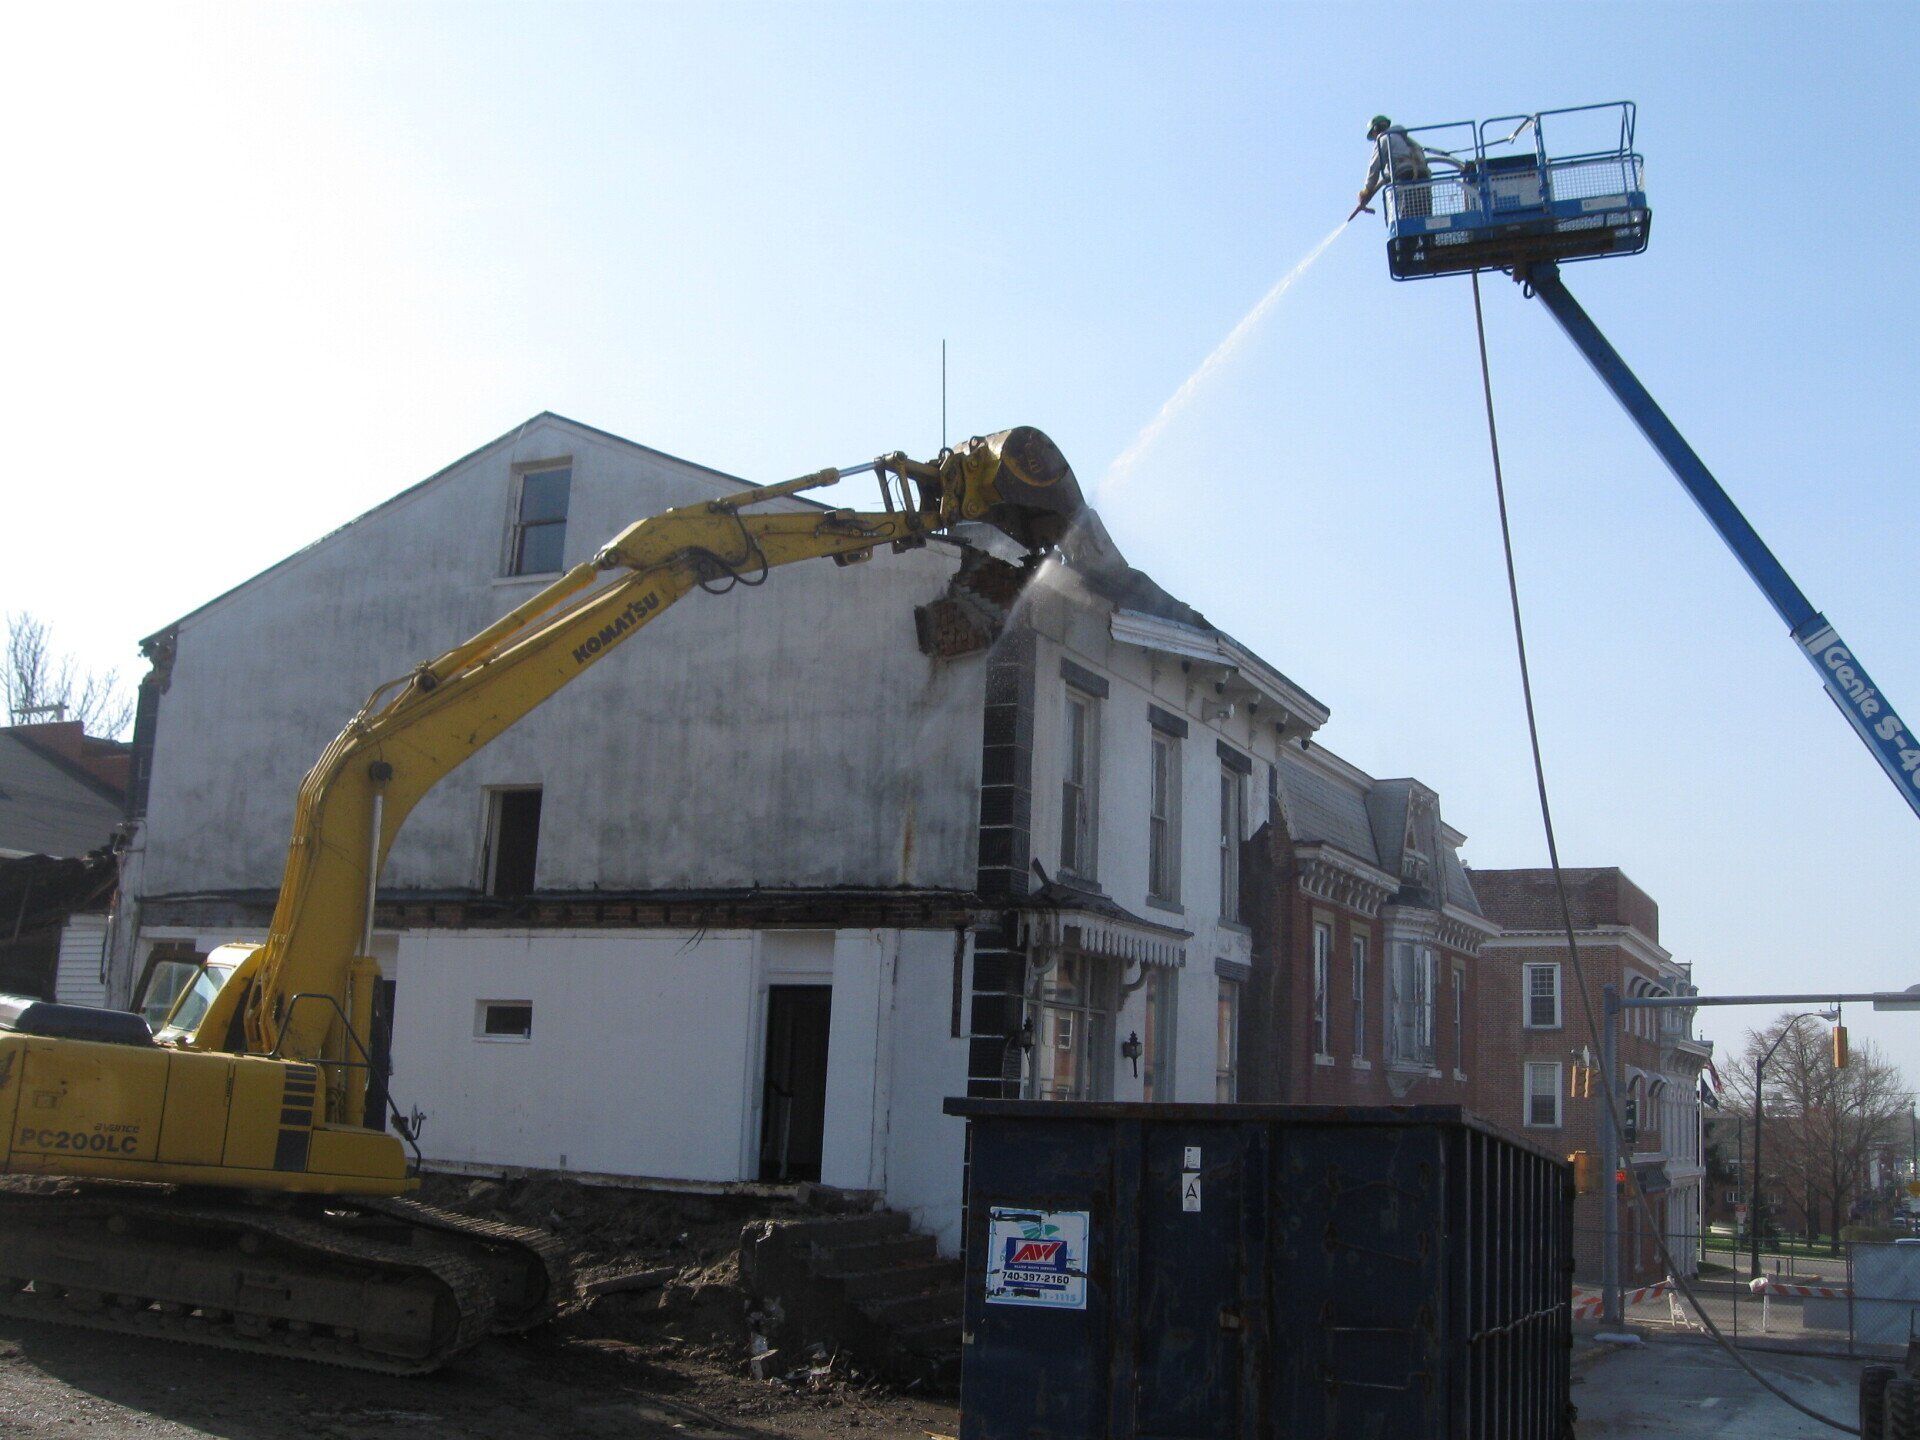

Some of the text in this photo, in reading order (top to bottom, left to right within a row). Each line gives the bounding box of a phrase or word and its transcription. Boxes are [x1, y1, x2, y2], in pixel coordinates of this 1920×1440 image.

[572, 591, 659, 664] KOMATSU
[1823, 646, 1880, 719] Genie
[19, 1127, 138, 1154] PC200LC
[1185, 1183, 1198, 1199] A
[1002, 1271, 1070, 1284] 740-397-2160
